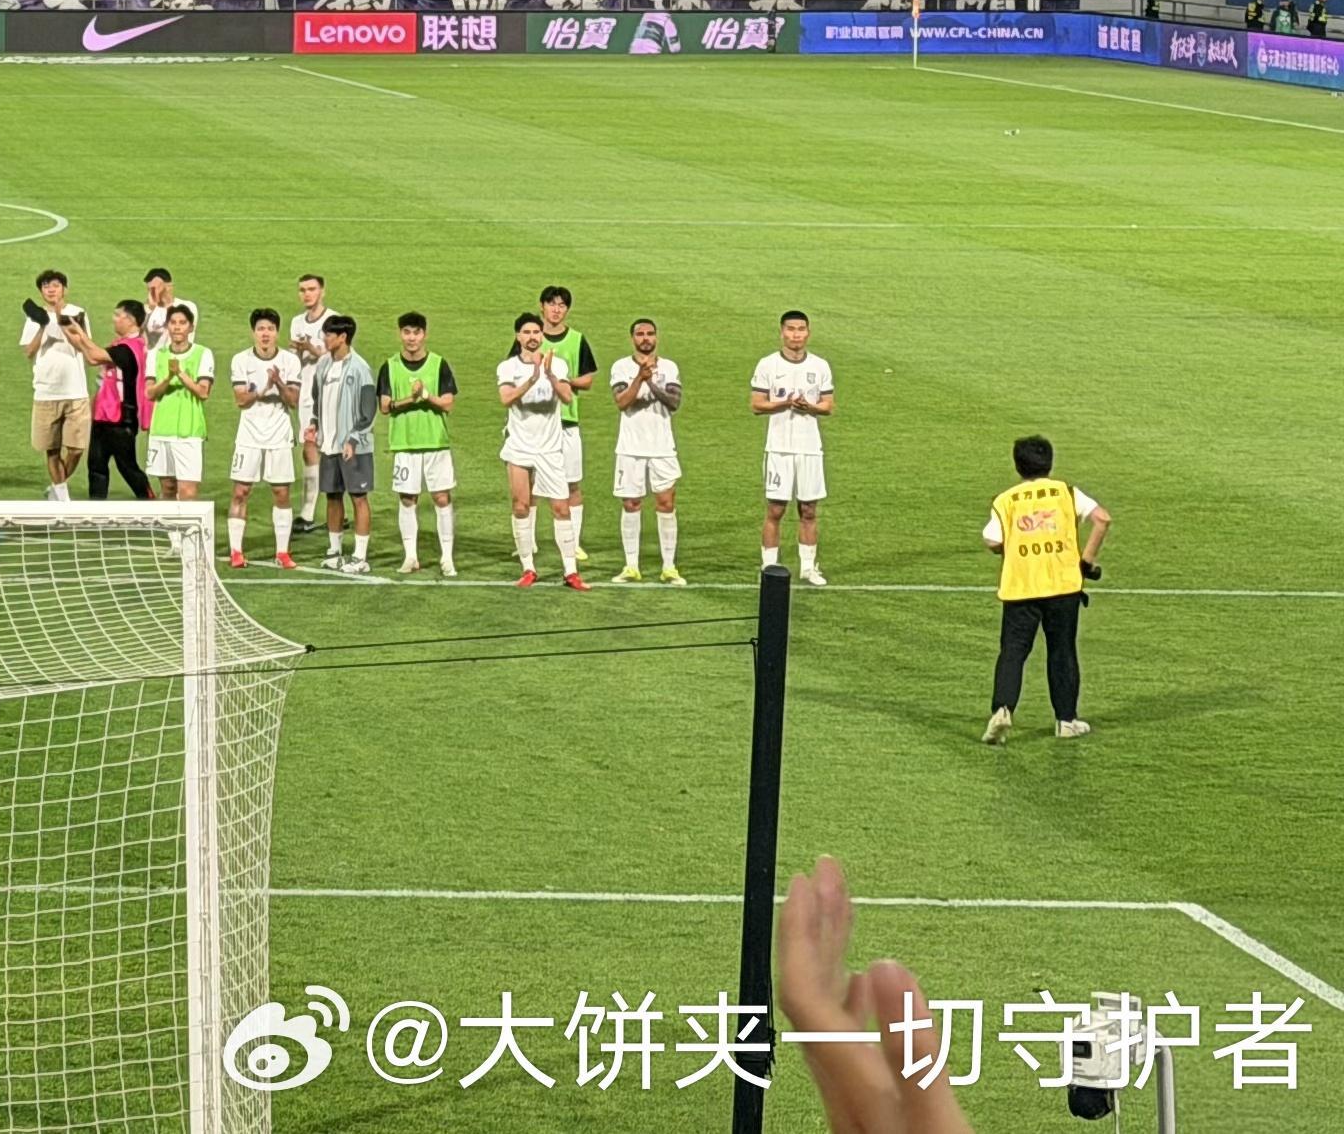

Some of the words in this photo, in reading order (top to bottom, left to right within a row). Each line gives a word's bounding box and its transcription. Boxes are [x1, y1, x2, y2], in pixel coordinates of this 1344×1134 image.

[304, 20, 406, 45] Lenovo
[423, 15, 498, 51] 联想
[393, 465, 409, 482] 20
[768, 470, 782, 488] 14
[1018, 540, 1064, 557] 0003
